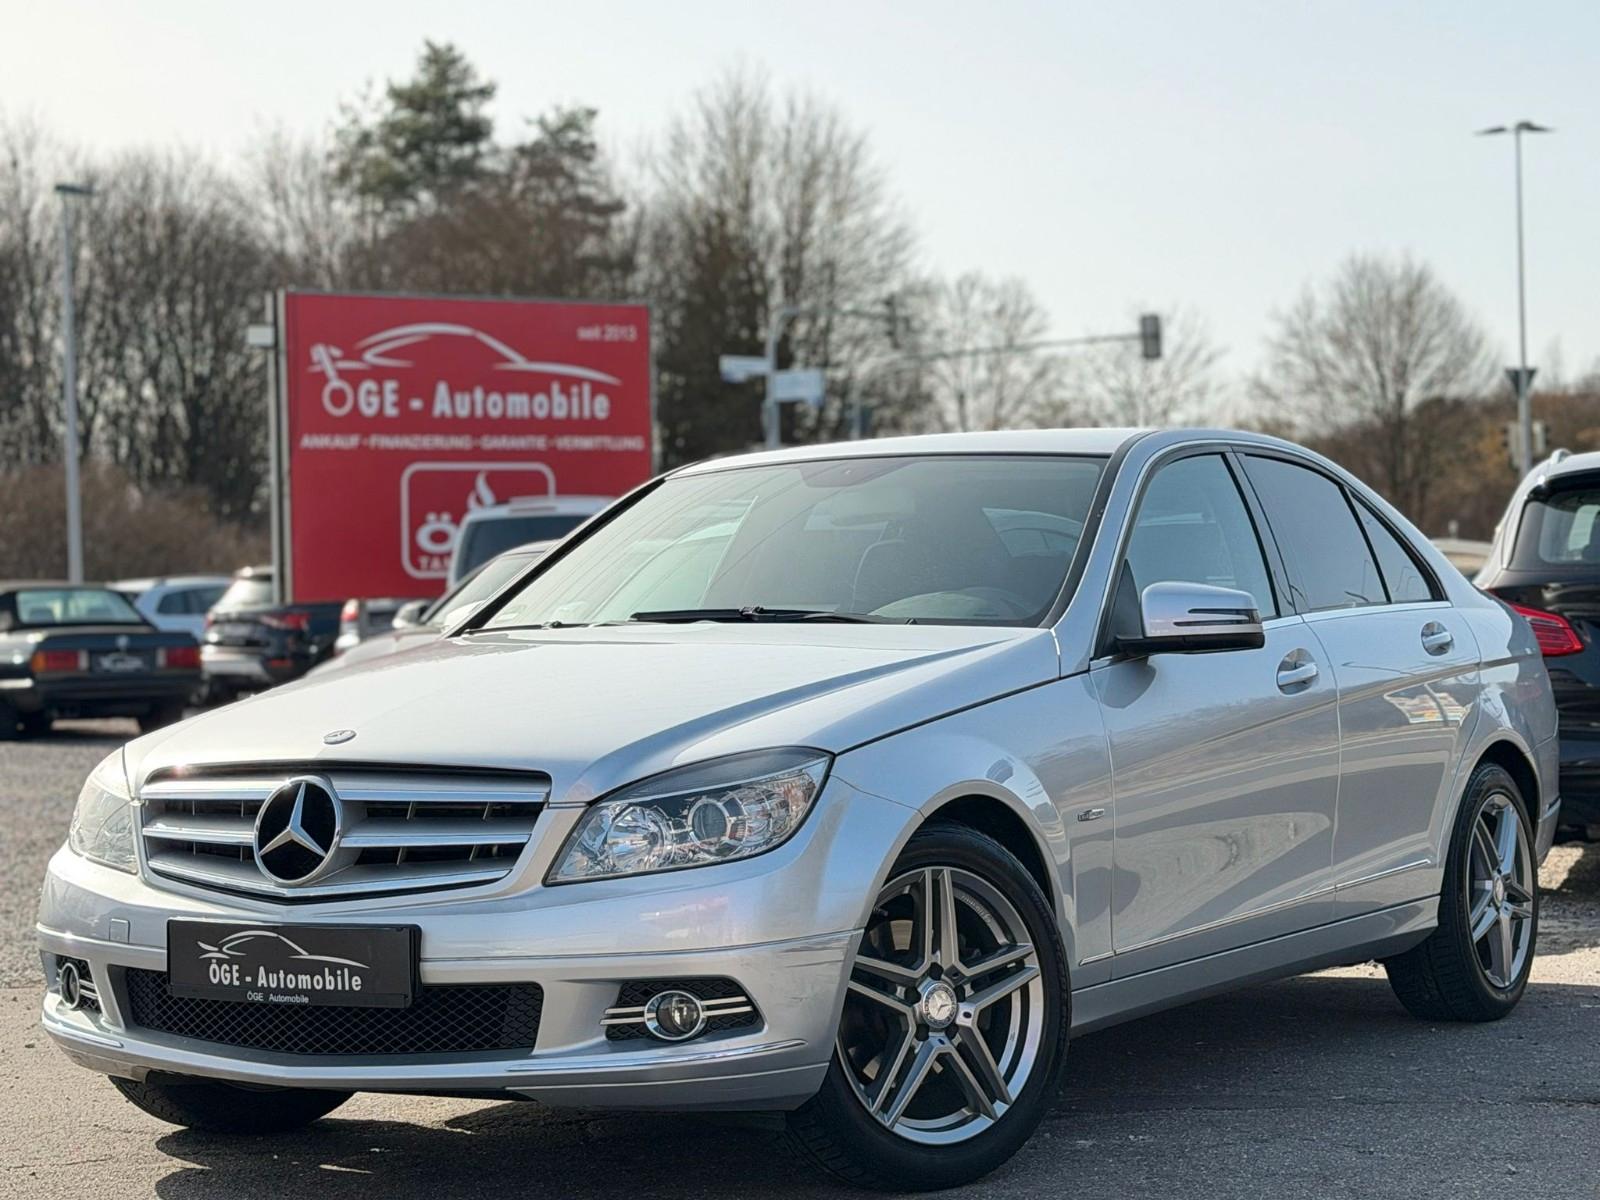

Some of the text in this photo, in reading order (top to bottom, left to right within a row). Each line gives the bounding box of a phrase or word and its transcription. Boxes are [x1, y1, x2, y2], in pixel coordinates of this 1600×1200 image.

[432, 379, 610, 419] Automobile
[257, 966, 363, 991] Automobile
[268, 993, 309, 1004] Automobile
